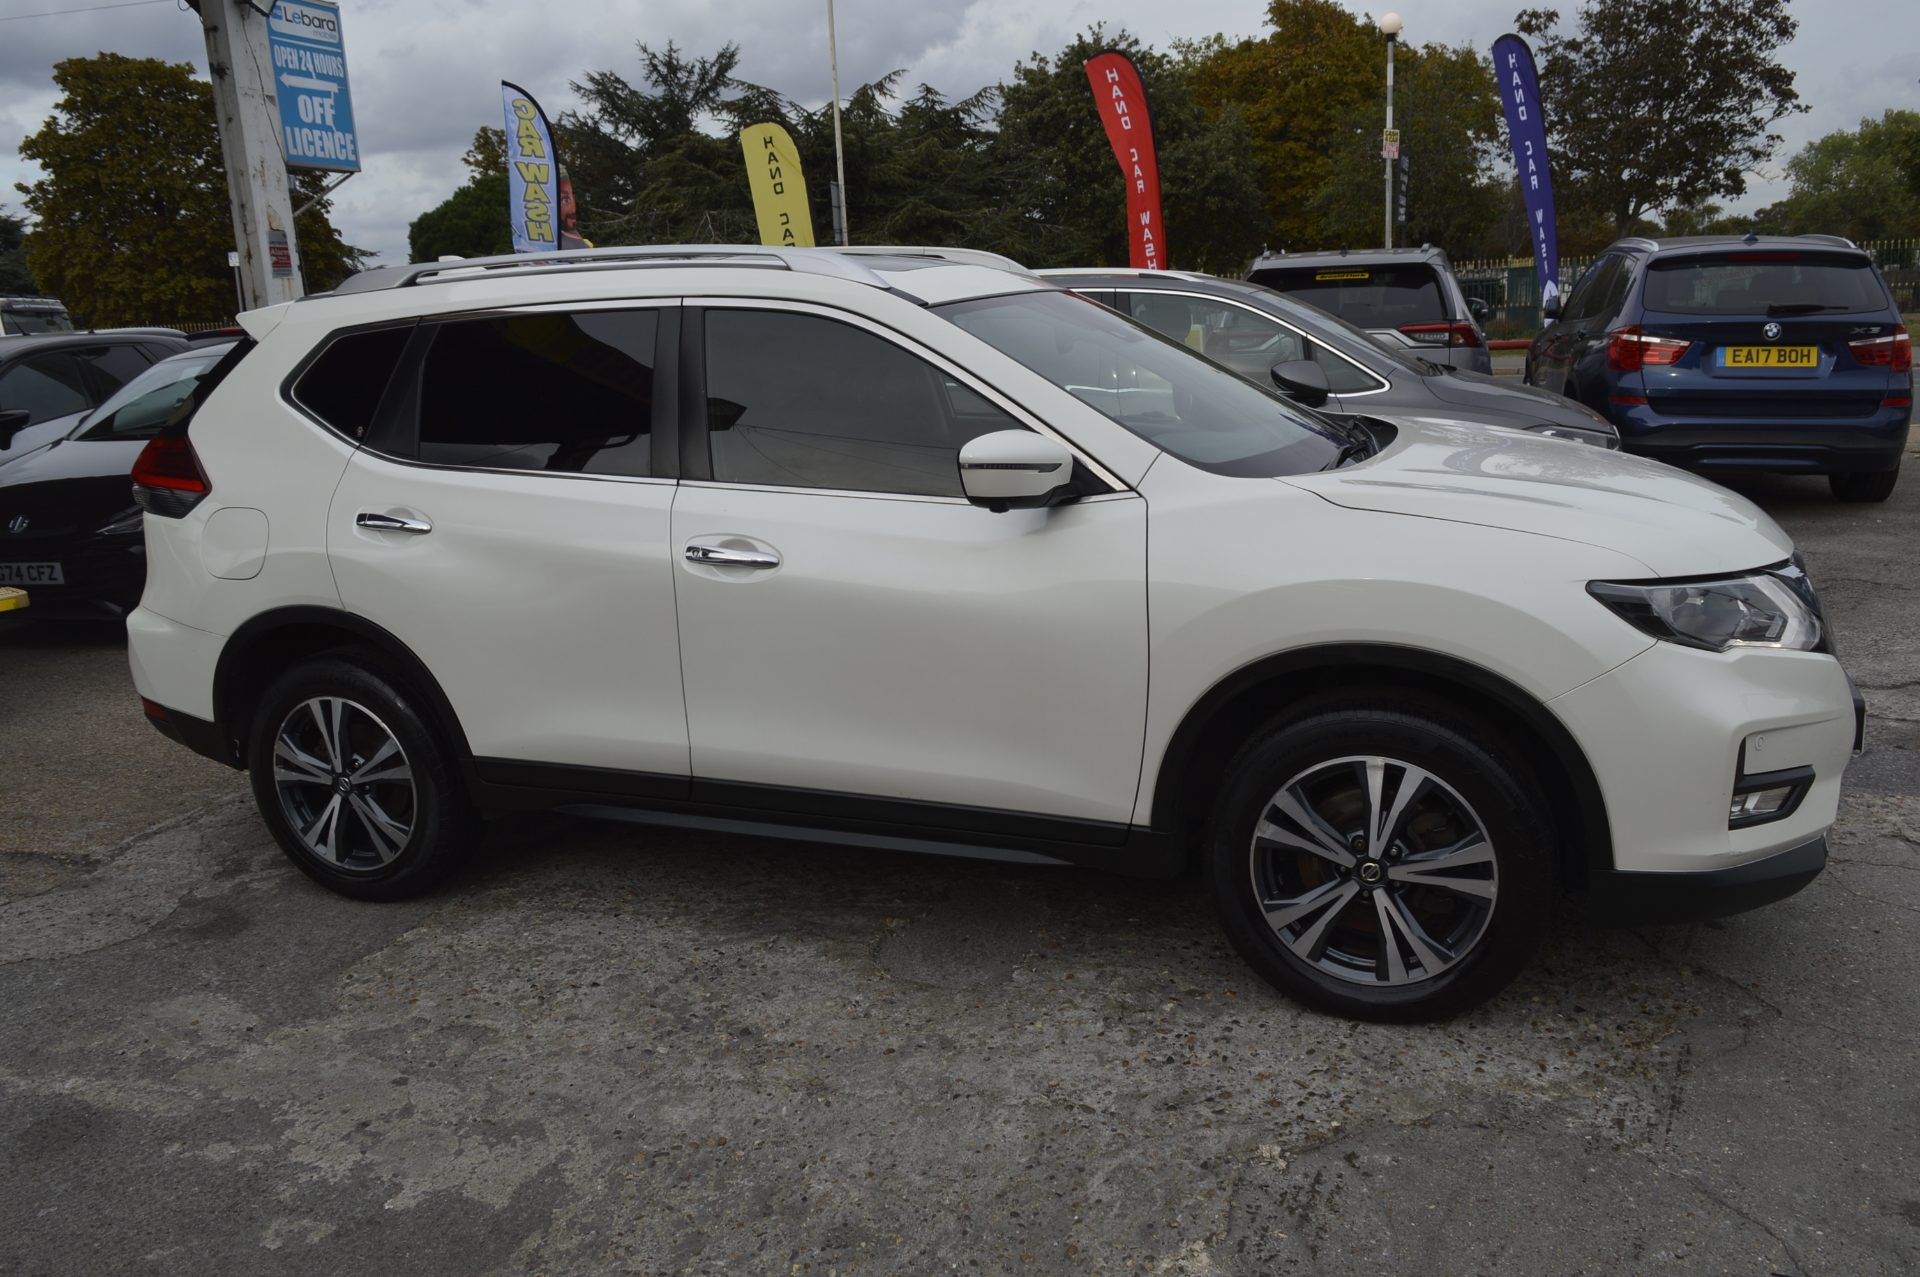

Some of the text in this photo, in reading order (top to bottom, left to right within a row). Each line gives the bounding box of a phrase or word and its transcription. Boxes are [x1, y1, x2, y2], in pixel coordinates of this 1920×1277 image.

[283, 6, 336, 32] Lebara
[273, 45, 344, 78] OPEN 24 HOURS
[297, 94, 336, 127] OFF
[285, 126, 357, 160] LICENCE
[1732, 348, 1811, 364] EA17 BOH
[27, 565, 58, 581] CFZ
